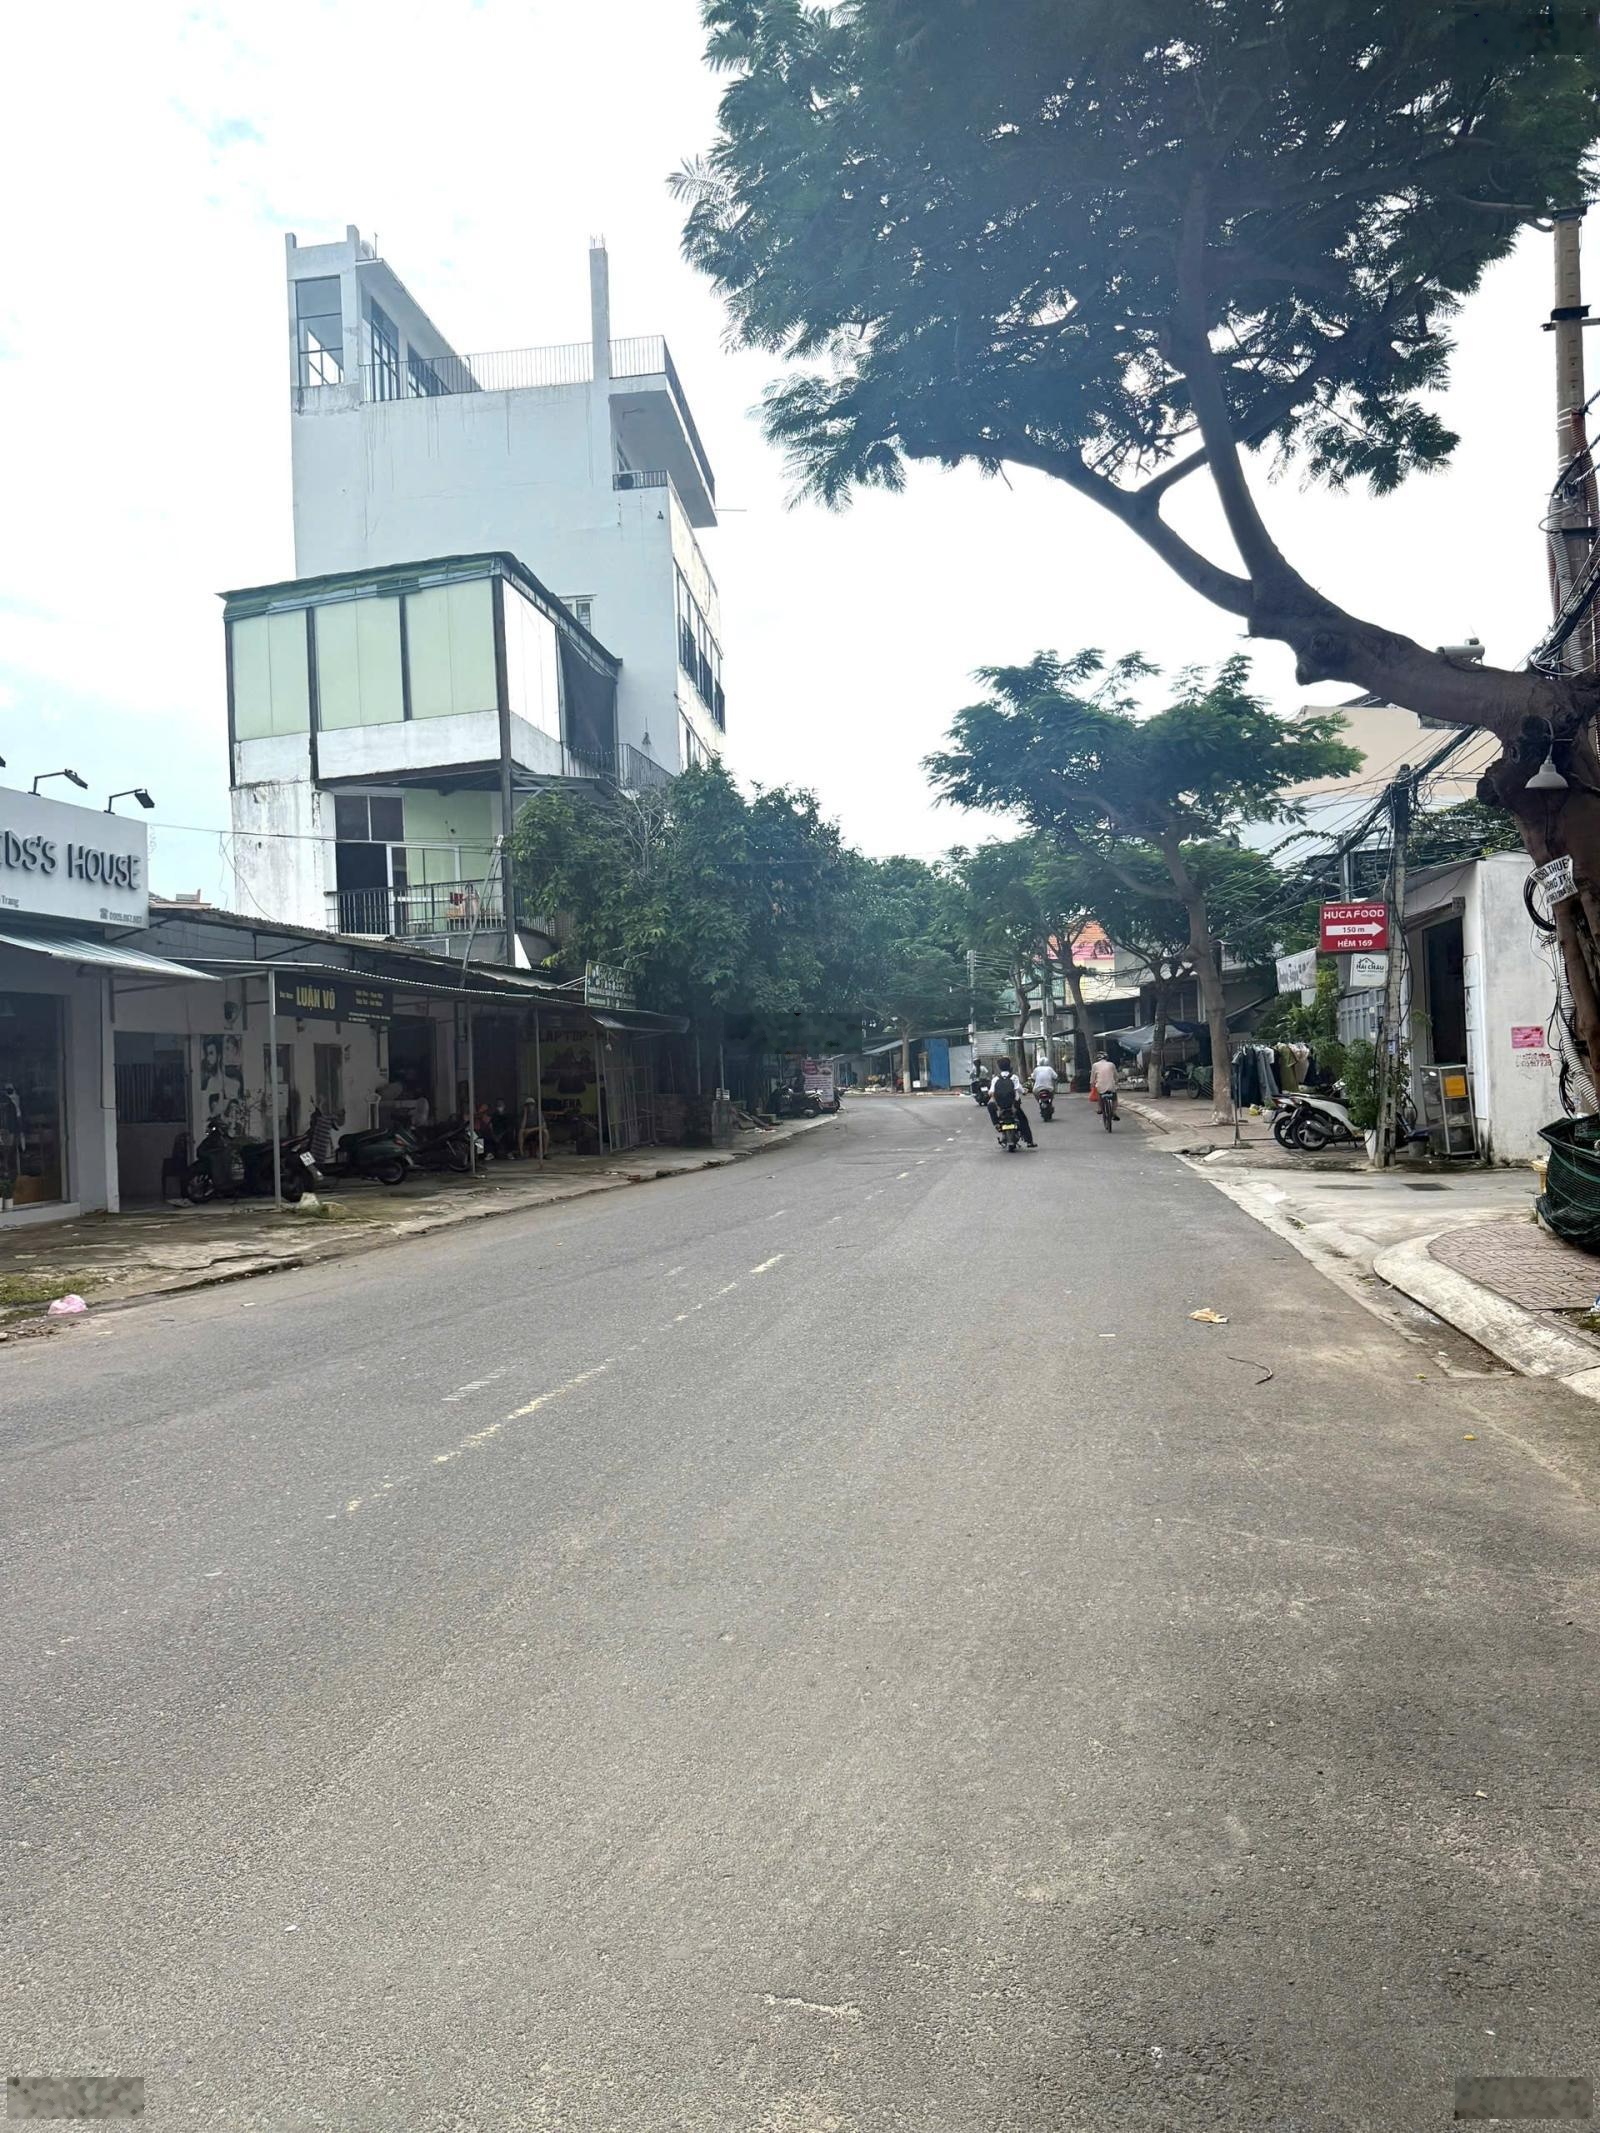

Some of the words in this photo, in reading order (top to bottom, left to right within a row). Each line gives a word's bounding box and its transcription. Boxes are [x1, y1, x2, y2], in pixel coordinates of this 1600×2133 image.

[0, 830, 57, 873] DS'S
[67, 843, 141, 890] HOUSE
[1324, 910, 1384, 919] HUCAFOOD
[1343, 926, 1356, 934] 150
[1358, 939, 1373, 947] 169
